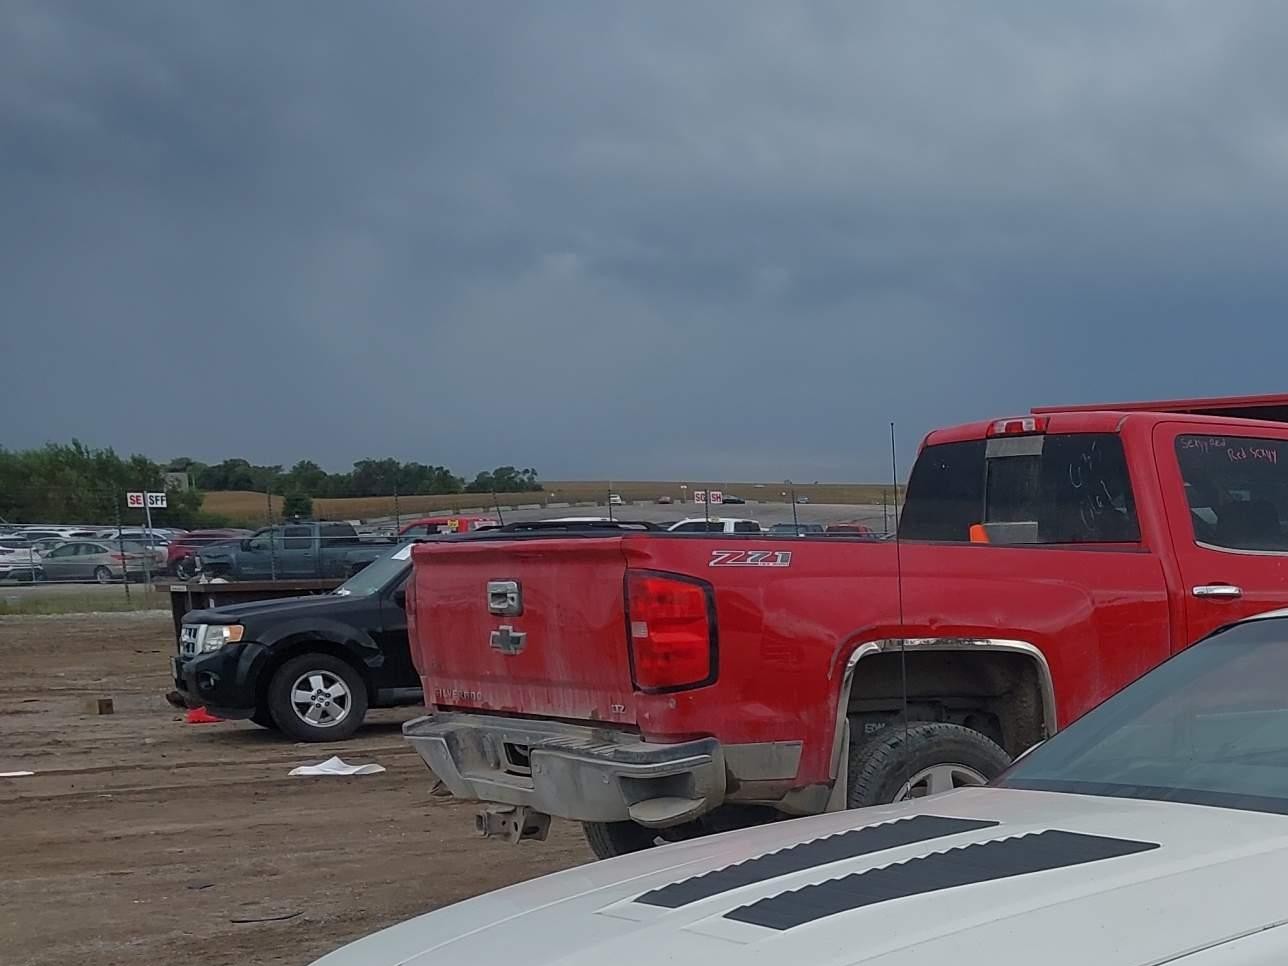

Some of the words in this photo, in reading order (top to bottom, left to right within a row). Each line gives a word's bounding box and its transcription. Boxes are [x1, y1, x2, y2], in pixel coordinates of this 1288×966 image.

[130, 495, 142, 505] SE
[149, 495, 166, 505] SFF
[709, 550, 792, 567] Z71
